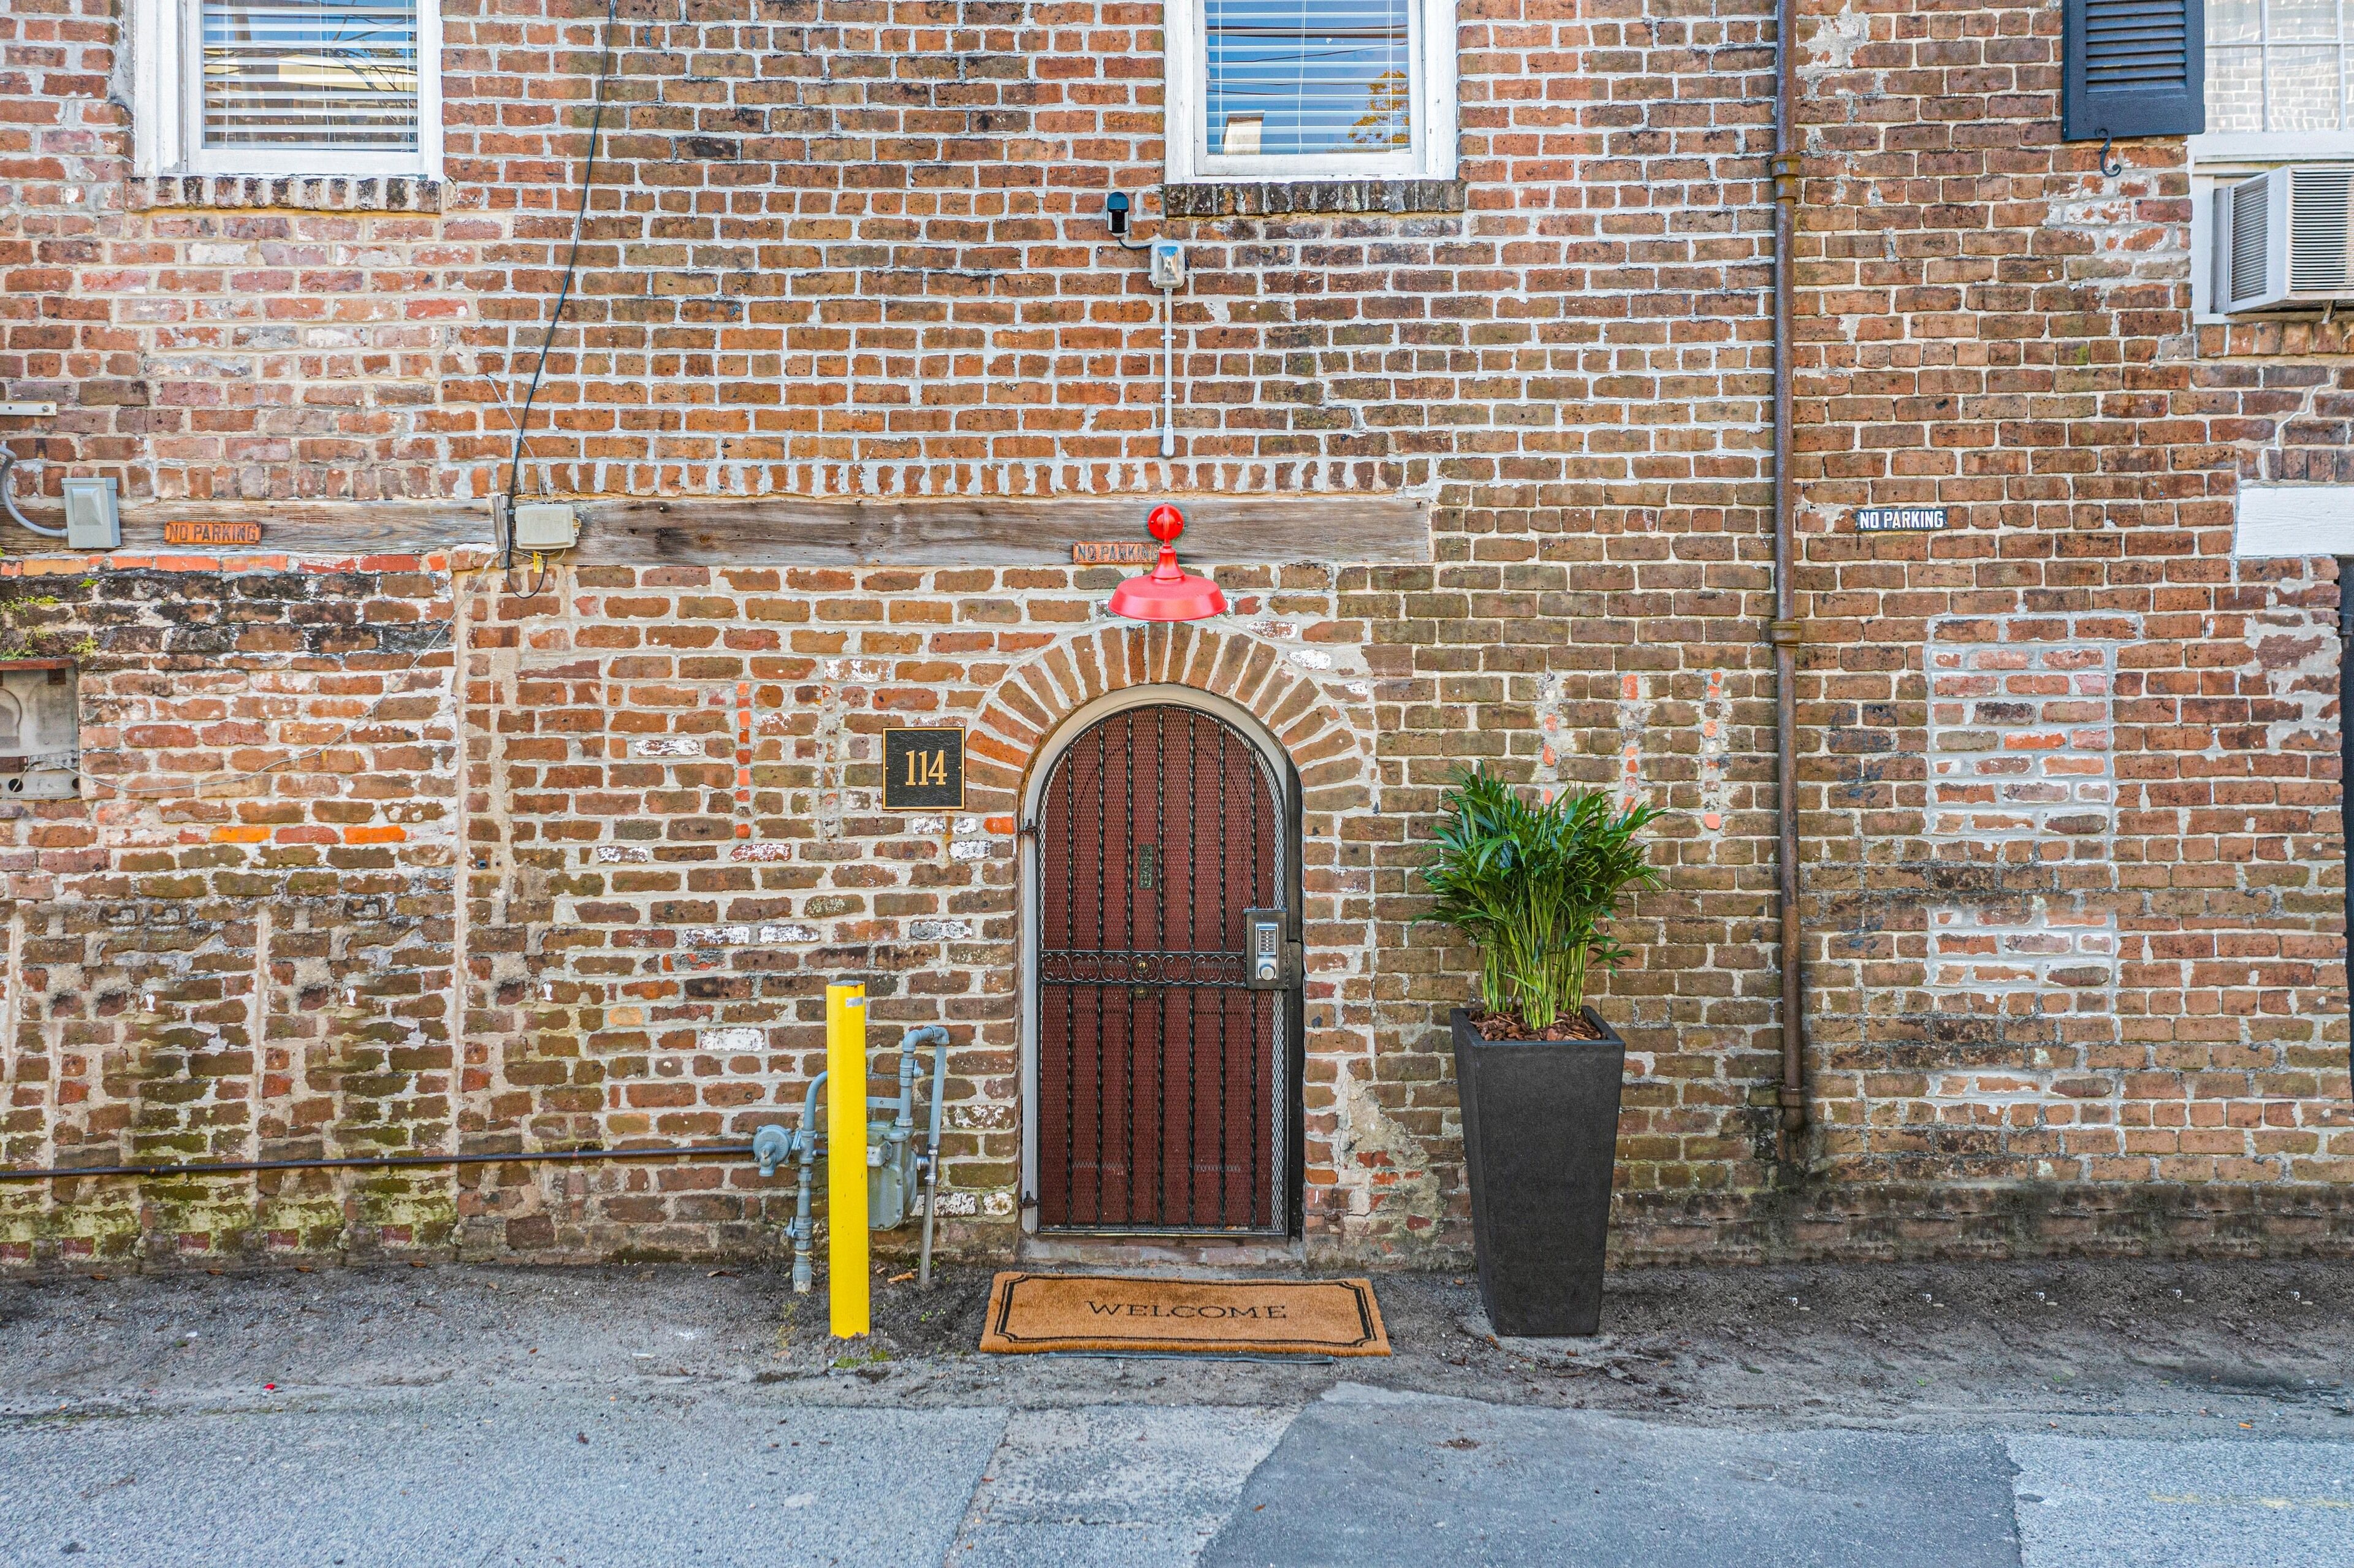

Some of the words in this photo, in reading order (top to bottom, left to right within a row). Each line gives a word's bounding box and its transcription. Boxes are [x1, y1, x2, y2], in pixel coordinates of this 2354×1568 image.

[1860, 511, 1880, 529] NO
[1884, 511, 1943, 528] PARKING
[169, 525, 189, 541] NO
[194, 525, 256, 542] PARKING
[1078, 544, 1096, 561] NO
[1100, 544, 1159, 561] PARKING
[905, 750, 948, 786] 114
[1084, 1300, 1287, 1319] WELCOME
